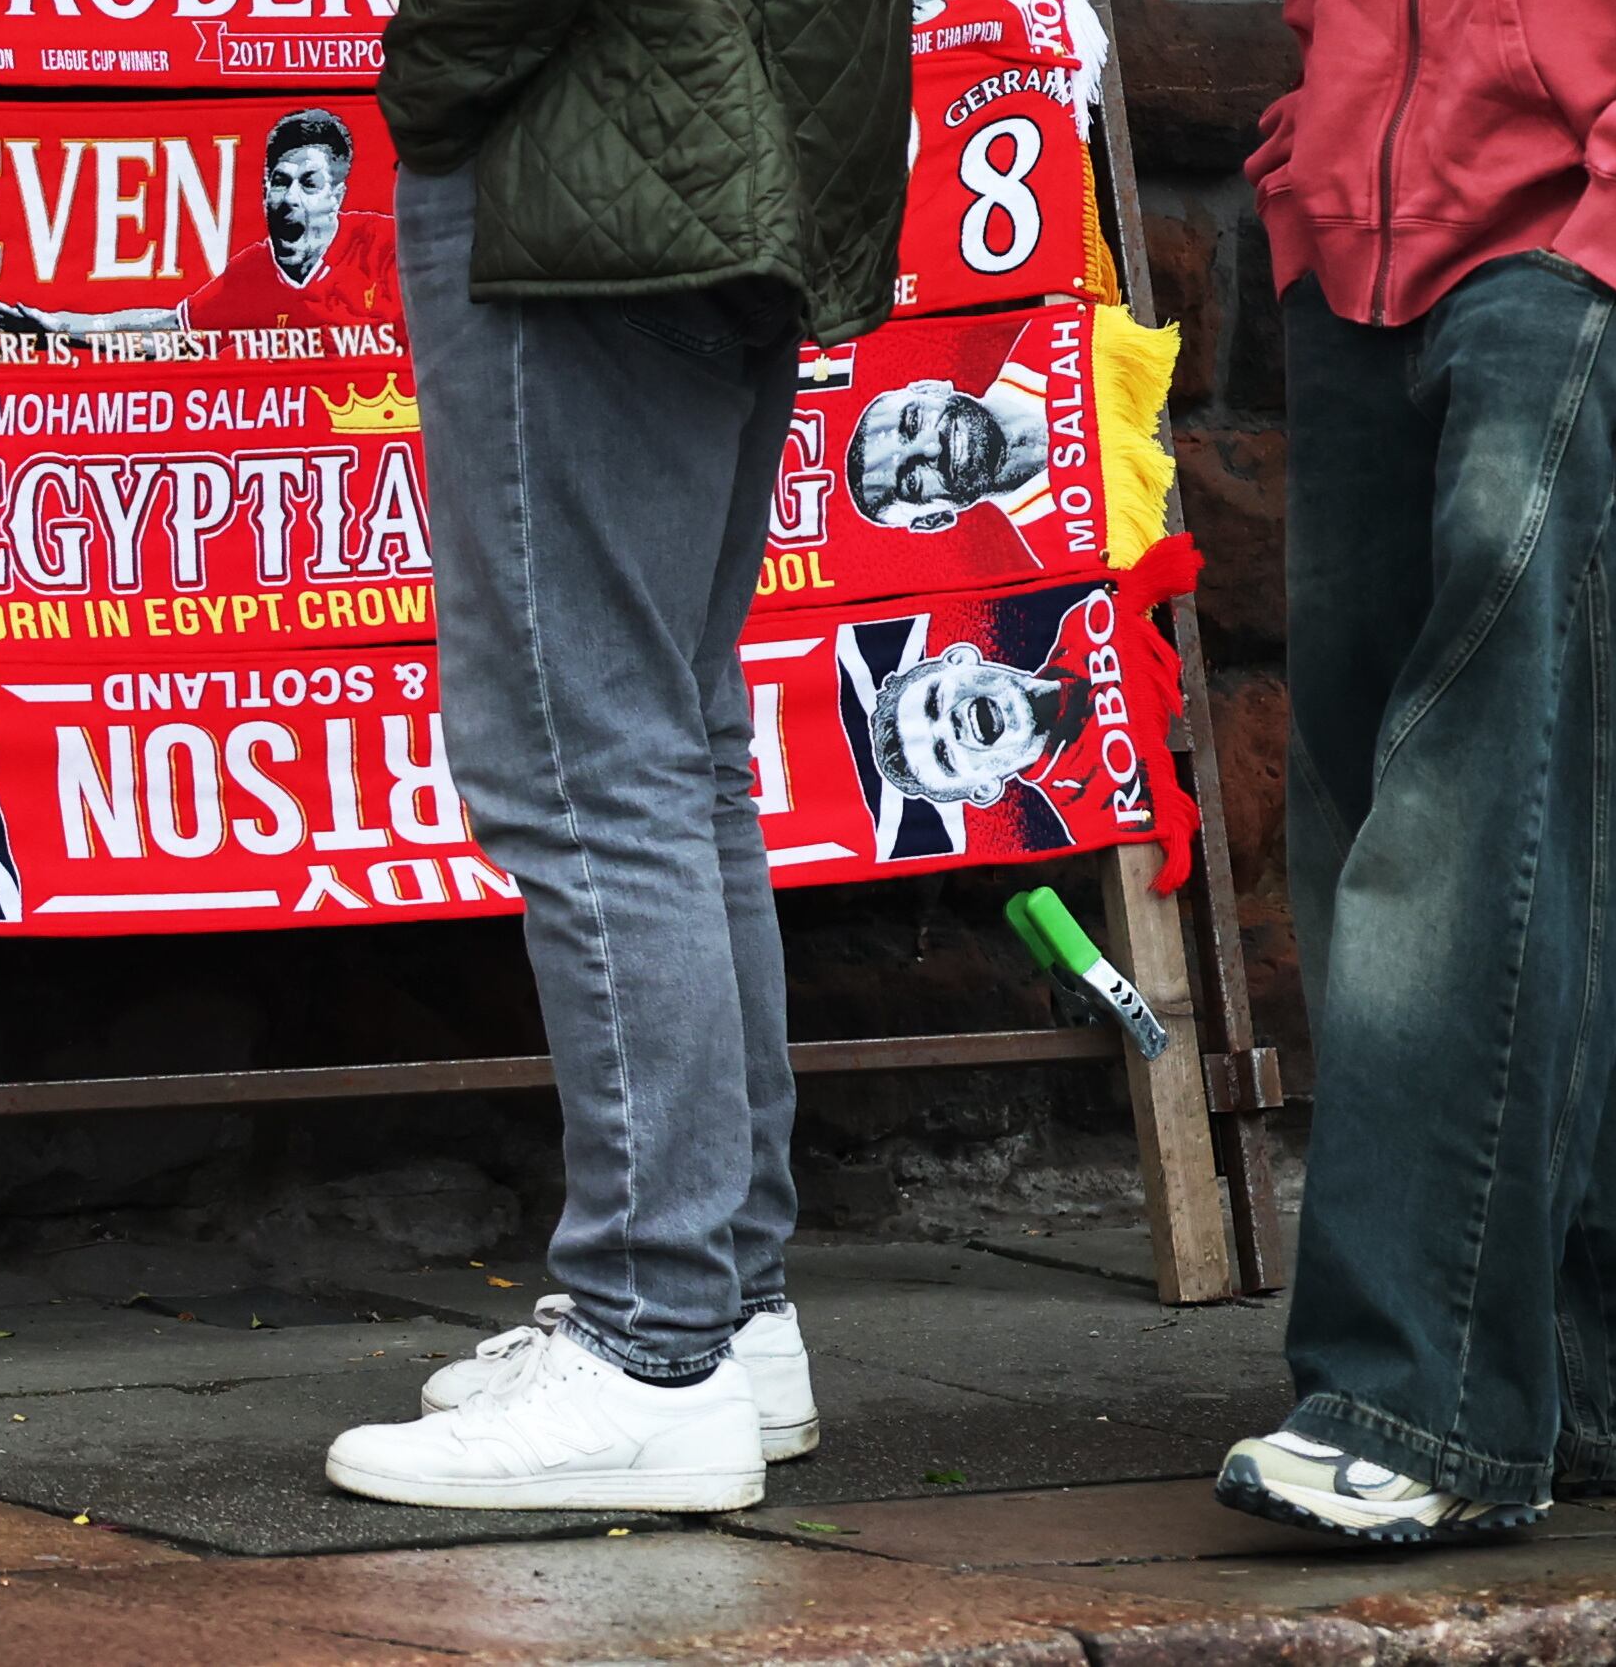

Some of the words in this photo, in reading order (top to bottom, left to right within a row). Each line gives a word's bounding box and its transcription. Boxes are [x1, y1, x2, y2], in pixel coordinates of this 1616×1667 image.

[41, 48, 88, 70] LEAGUE
[91, 50, 118, 71] CUP
[120, 50, 169, 72] WINNER
[227, 41, 274, 67] 2017
[285, 39, 385, 68] LIVERPO
[911, 30, 933, 55] GUE
[936, 21, 1003, 50] CHAMPION
[959, 115, 1043, 275] 8
[46, 334, 79, 368] IS,
[86, 333, 147, 364] THE
[155, 330, 223, 362] BEST
[228, 327, 325, 361] THERE
[328, 323, 403, 358] WAS,
[185, 386, 307, 431] SALAH
[1051, 320, 1086, 468] SALAH
[1058, 485, 1096, 554] MO
[85, 598, 132, 637] IN
[147, 592, 292, 637] EGYPT,
[297, 585, 435, 631] CROW
[103, 665, 375, 711] SCOTLAND
[391, 662, 428, 701] &
[1084, 588, 1150, 824] ROBBO
[56, 712, 475, 859] RTSON
[293, 856, 523, 913] NDY
